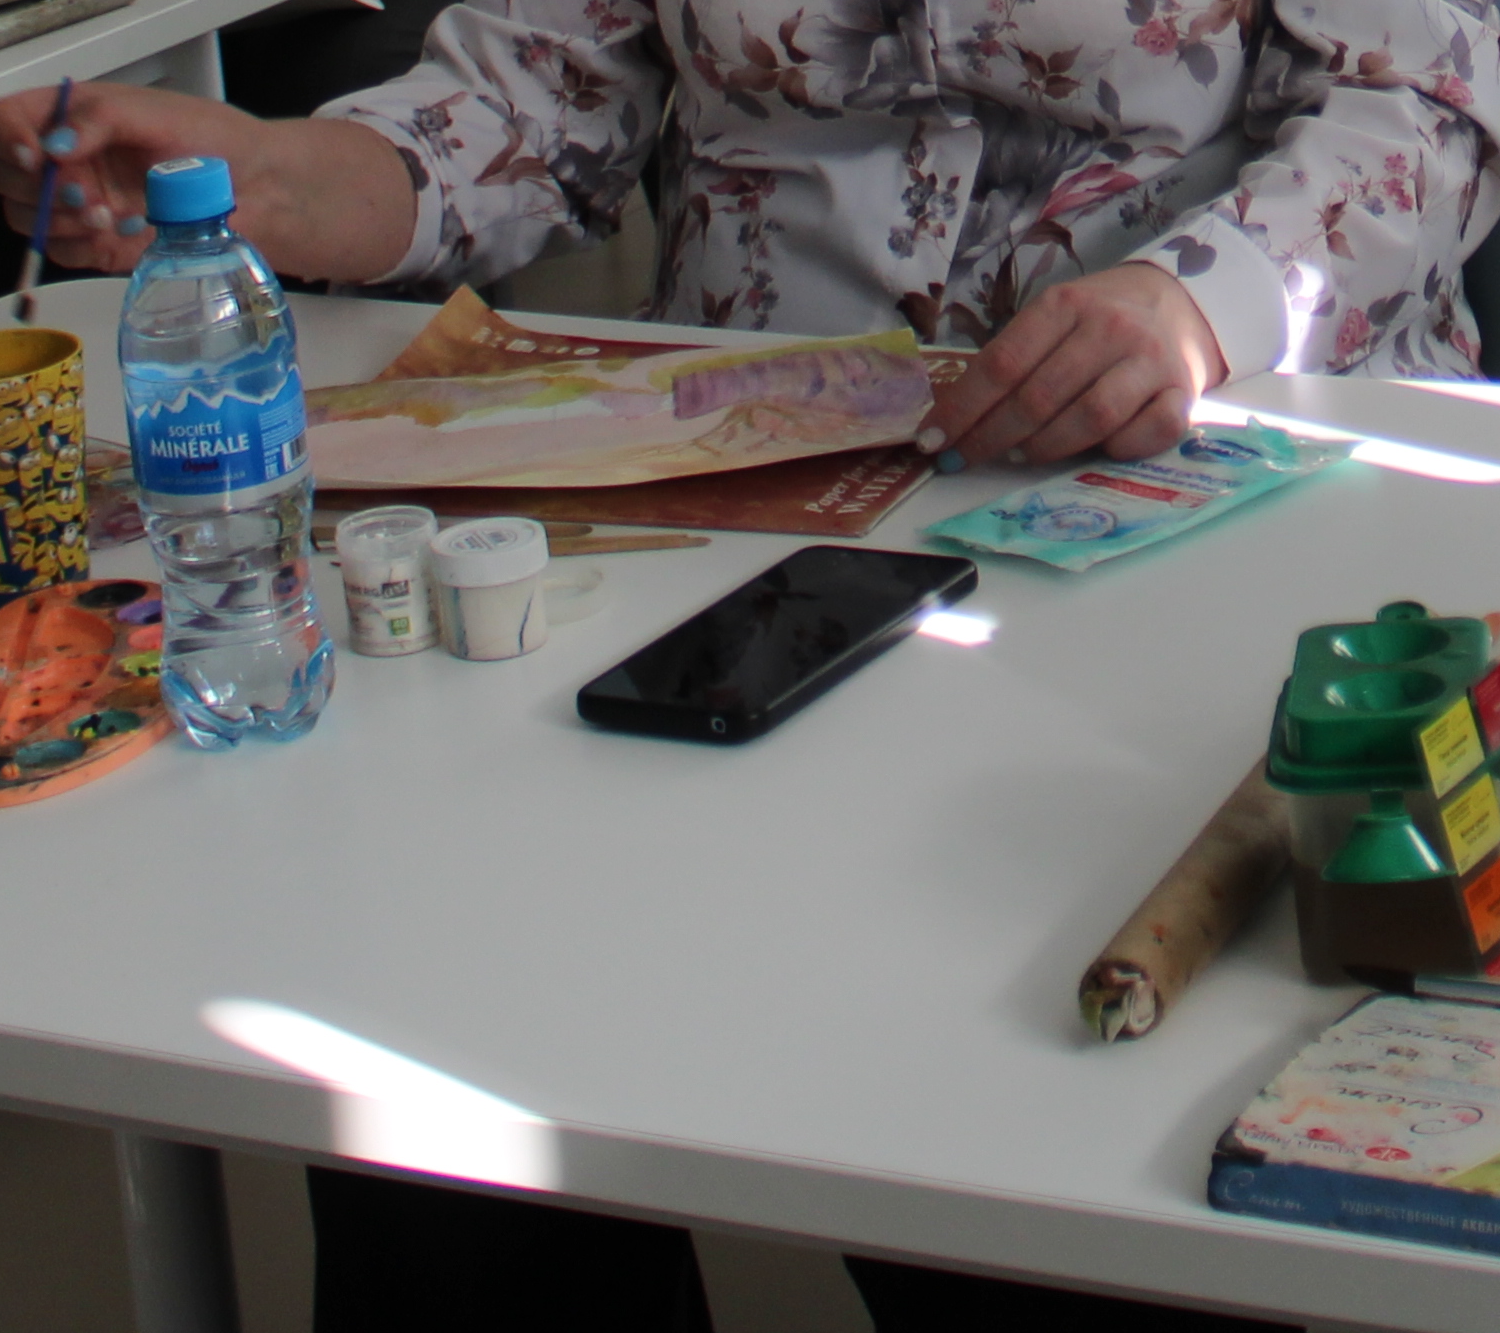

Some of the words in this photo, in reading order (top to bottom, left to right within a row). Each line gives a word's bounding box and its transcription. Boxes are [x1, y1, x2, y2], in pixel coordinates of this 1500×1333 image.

[168, 419, 223, 438] SOCIÉTÉ
[151, 433, 250, 459] MINÉRALE
[804, 481, 849, 513] Paper
